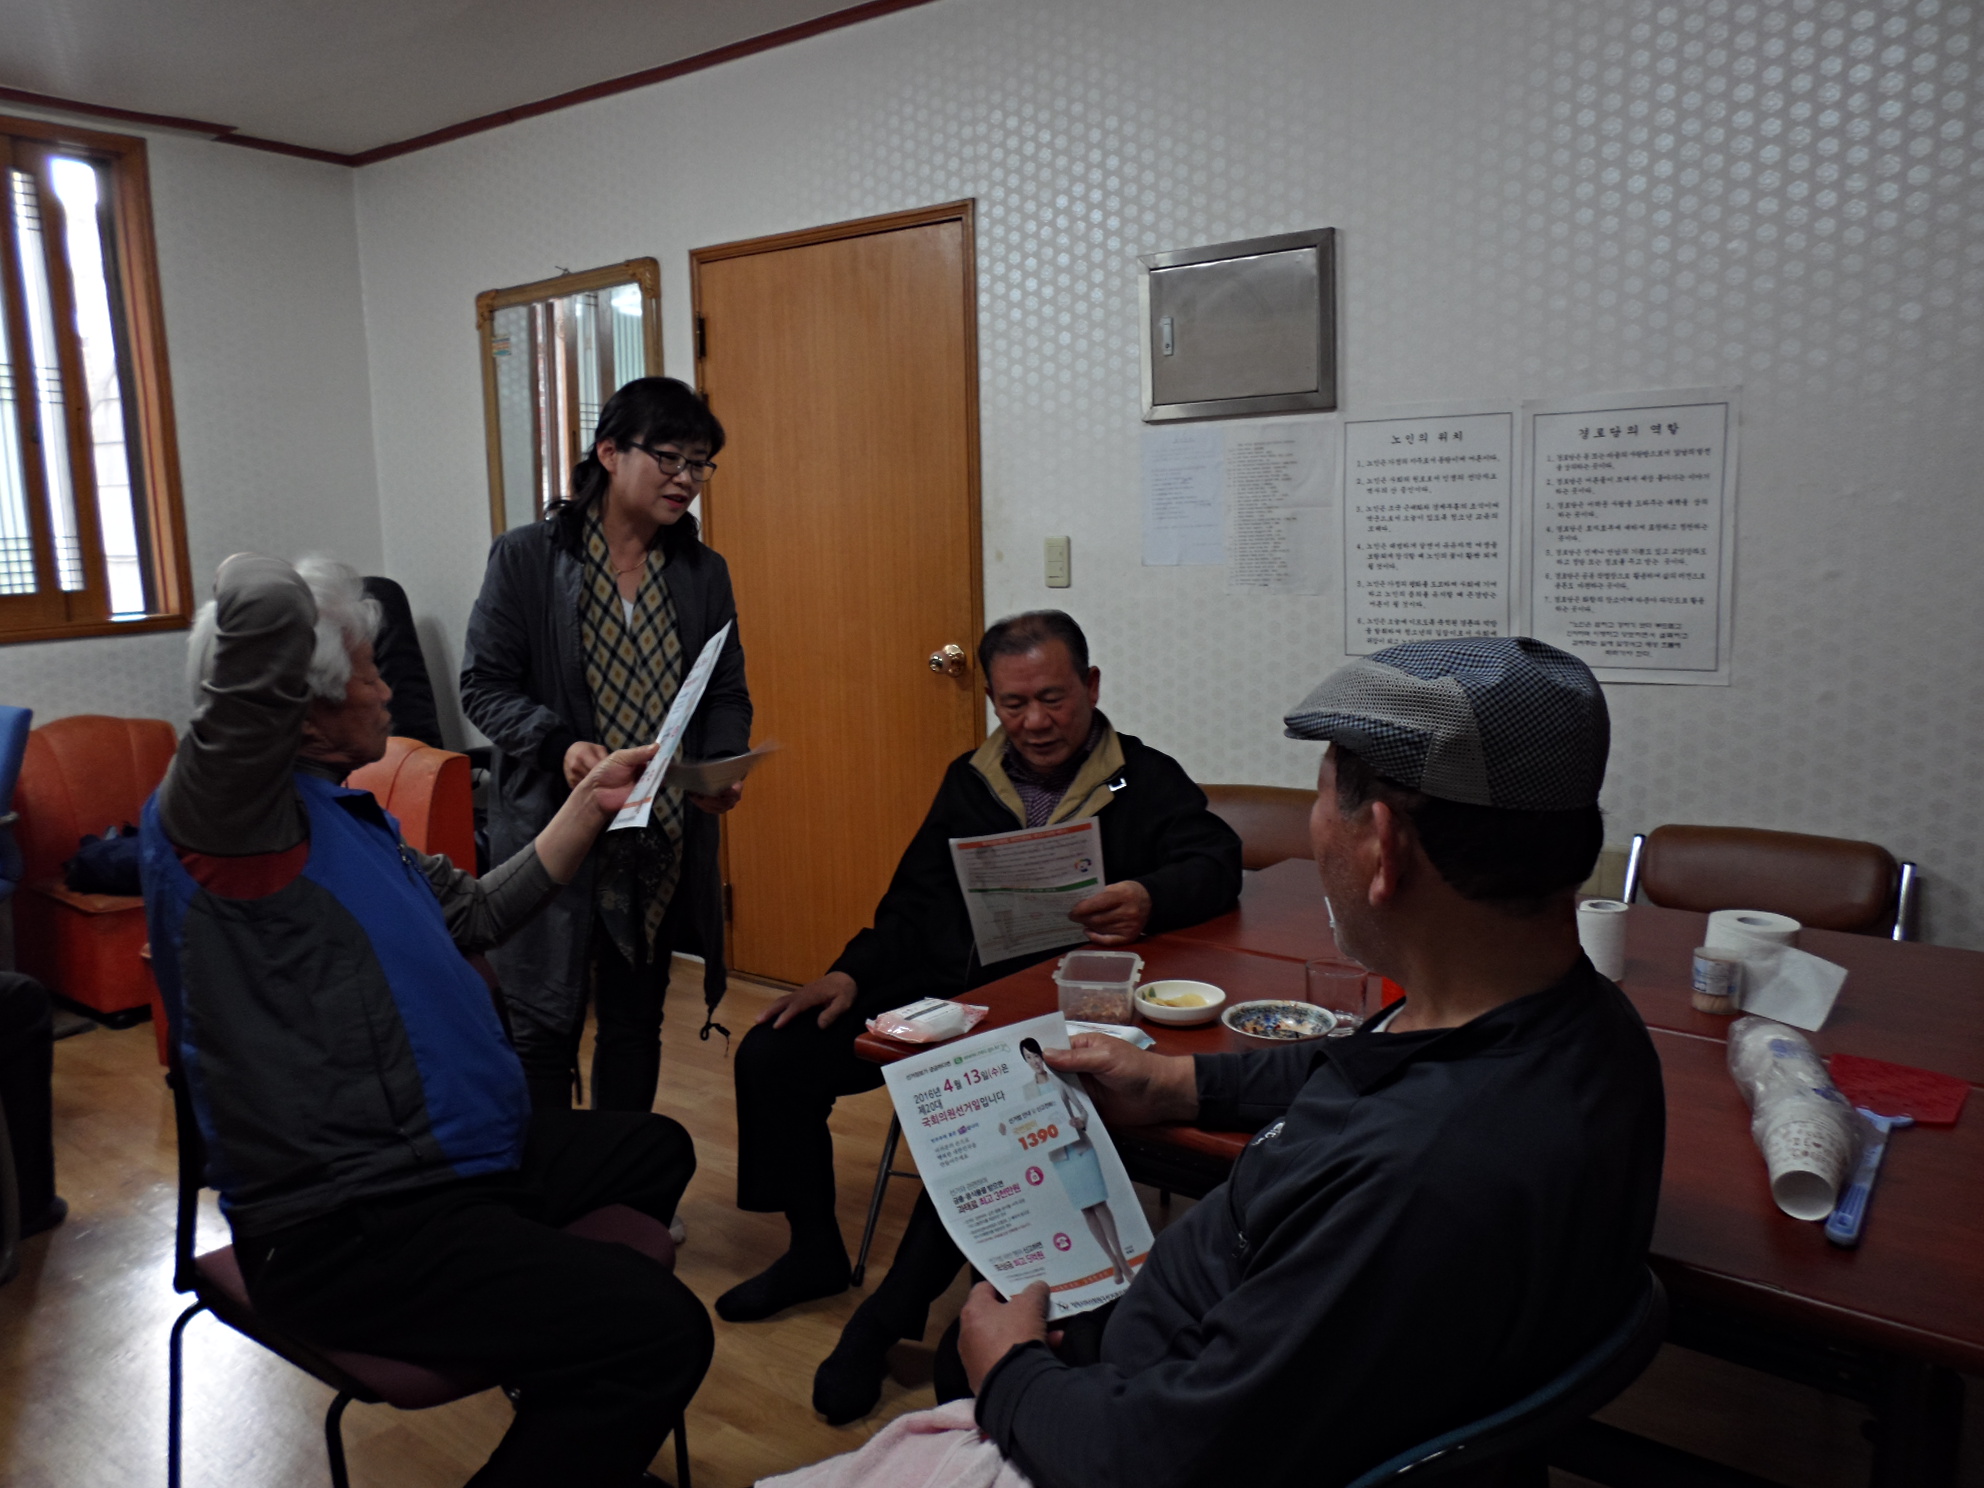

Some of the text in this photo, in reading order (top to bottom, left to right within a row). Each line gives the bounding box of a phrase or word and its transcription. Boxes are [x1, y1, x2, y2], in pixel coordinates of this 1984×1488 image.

[1391, 431, 1463, 445] 노인의 위치
[1579, 423, 1679, 440] 경로당의 역할
[913, 1086, 943, 1104] 2016년
[918, 1099, 944, 1115] 제20대
[921, 1090, 1006, 1127] 국회의원선거일입니다
[1018, 1124, 1059, 1151] 1390
